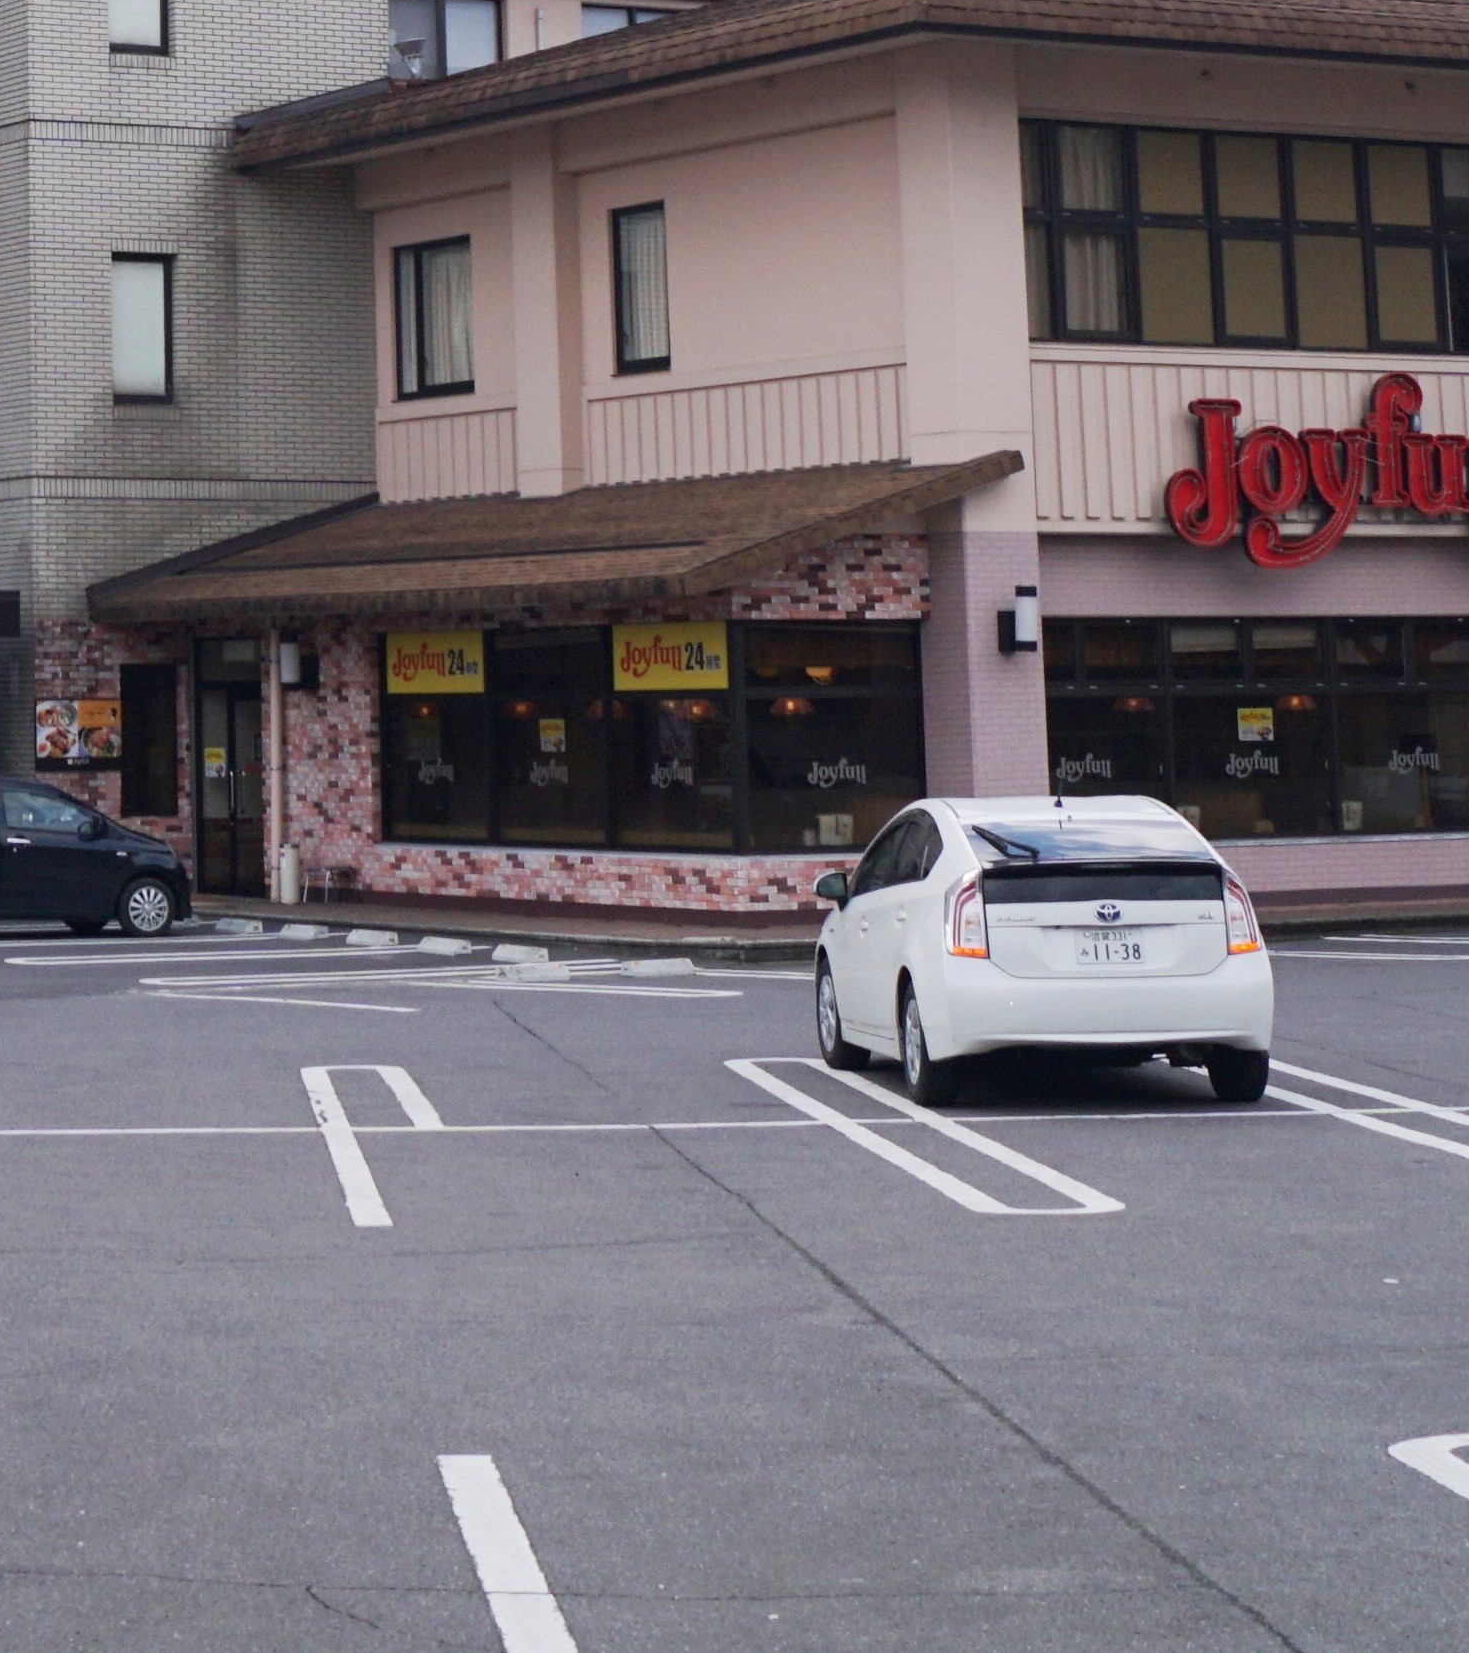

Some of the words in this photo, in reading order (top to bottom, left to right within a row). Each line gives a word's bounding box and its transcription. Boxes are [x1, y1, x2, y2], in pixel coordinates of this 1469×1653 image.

[392, 642, 446, 682] Joyfull
[620, 634, 683, 678] Joyfull
[807, 757, 866, 788] Joyfull
[1056, 752, 1111, 783] Joyfull
[1226, 749, 1279, 778] Joyfull
[1388, 746, 1439, 774] Joyfull
[1093, 943, 1141, 961] 11-38
